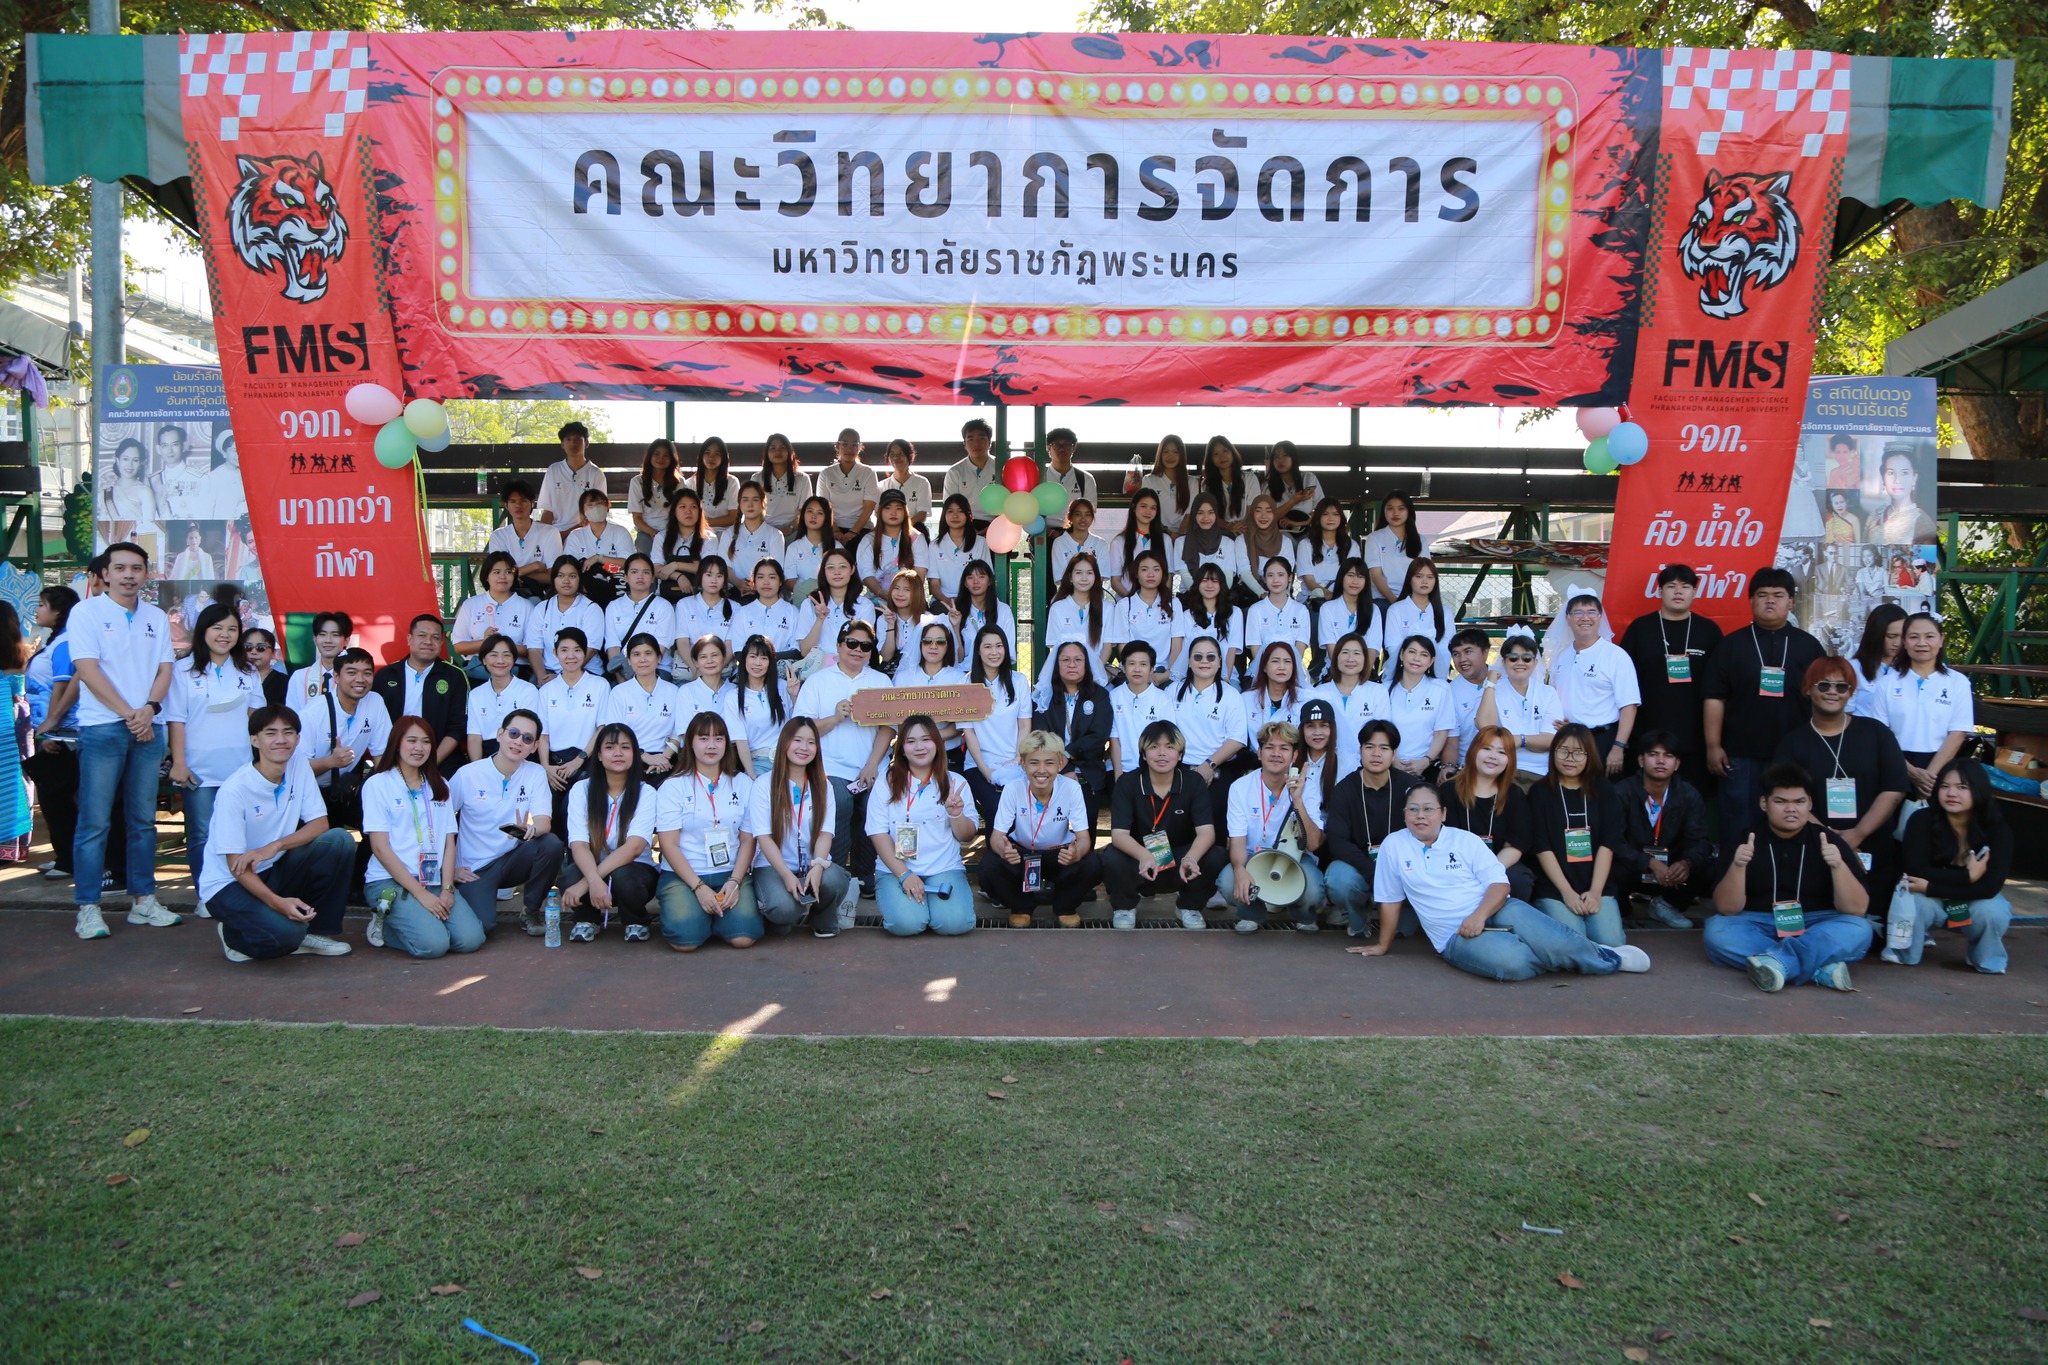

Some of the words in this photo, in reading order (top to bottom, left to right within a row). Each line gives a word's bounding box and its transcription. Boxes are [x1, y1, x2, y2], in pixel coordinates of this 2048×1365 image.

[573, 128, 1481, 223] คณะวิทยาการจัดการ
[773, 238, 1238, 285] มหาวิทยาลัยราชภัฏพระนคร
[242, 322, 371, 375] FMS
[1663, 339, 1790, 389] FMS
[243, 391, 295, 399] PHRANAKHON
[298, 390, 335, 398] RAJABHAT
[244, 382, 275, 390] FACULTY
[291, 380, 344, 388] MANAGEMENT
[1702, 396, 1755, 404] MANAGEMENT
[1829, 385, 1912, 401] สถิตในดวง
[108, 408, 182, 418] คณะวิทยาการจัดการ
[1650, 404, 1703, 412] PHRANAKHON
[1706, 405, 1744, 413] RAJABHAT
[1816, 401, 1909, 418] ตราบนิรันดร์
[280, 409, 353, 439] วจก.
[1679, 423, 1748, 453] วจก.
[279, 485, 392, 526] มากกว่า
[1643, 510, 1688, 547] คือ
[1695, 503, 1764, 547] น้ำใจ
[315, 542, 375, 578] กีฬา
[1644, 563, 1747, 599] นกีฬา
